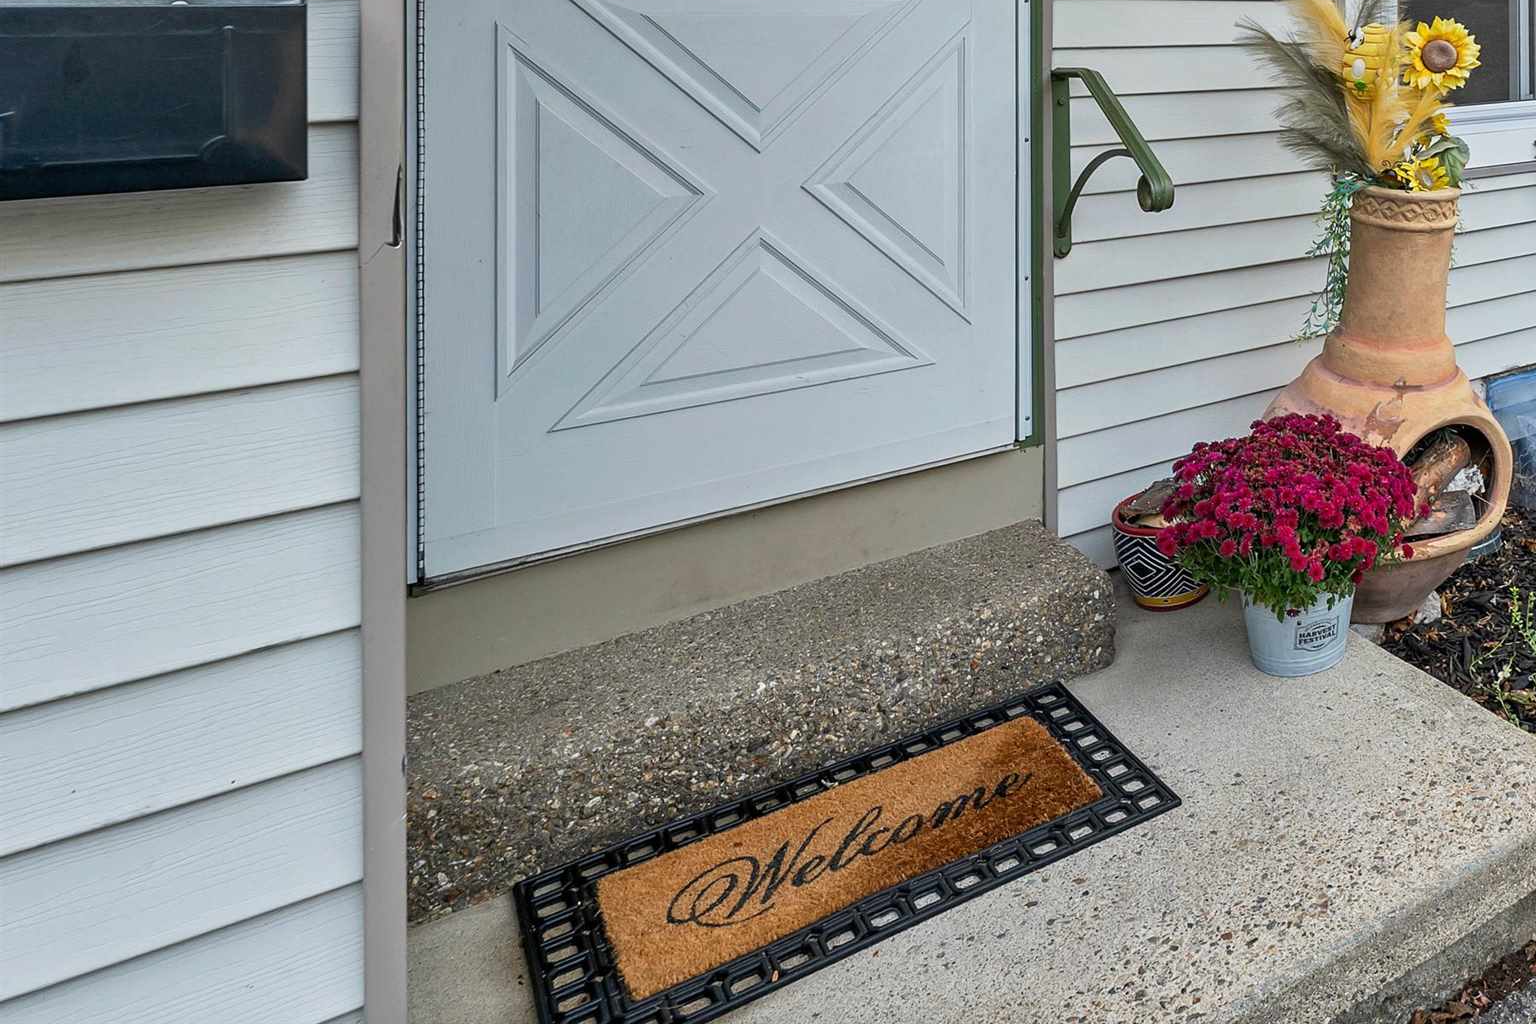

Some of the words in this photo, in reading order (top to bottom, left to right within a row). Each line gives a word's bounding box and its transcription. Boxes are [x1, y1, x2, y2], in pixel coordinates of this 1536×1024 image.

[1298, 629, 1337, 646] FESTIVAL
[1299, 623, 1337, 638] HARVEST
[666, 772, 1033, 928] Welcome
